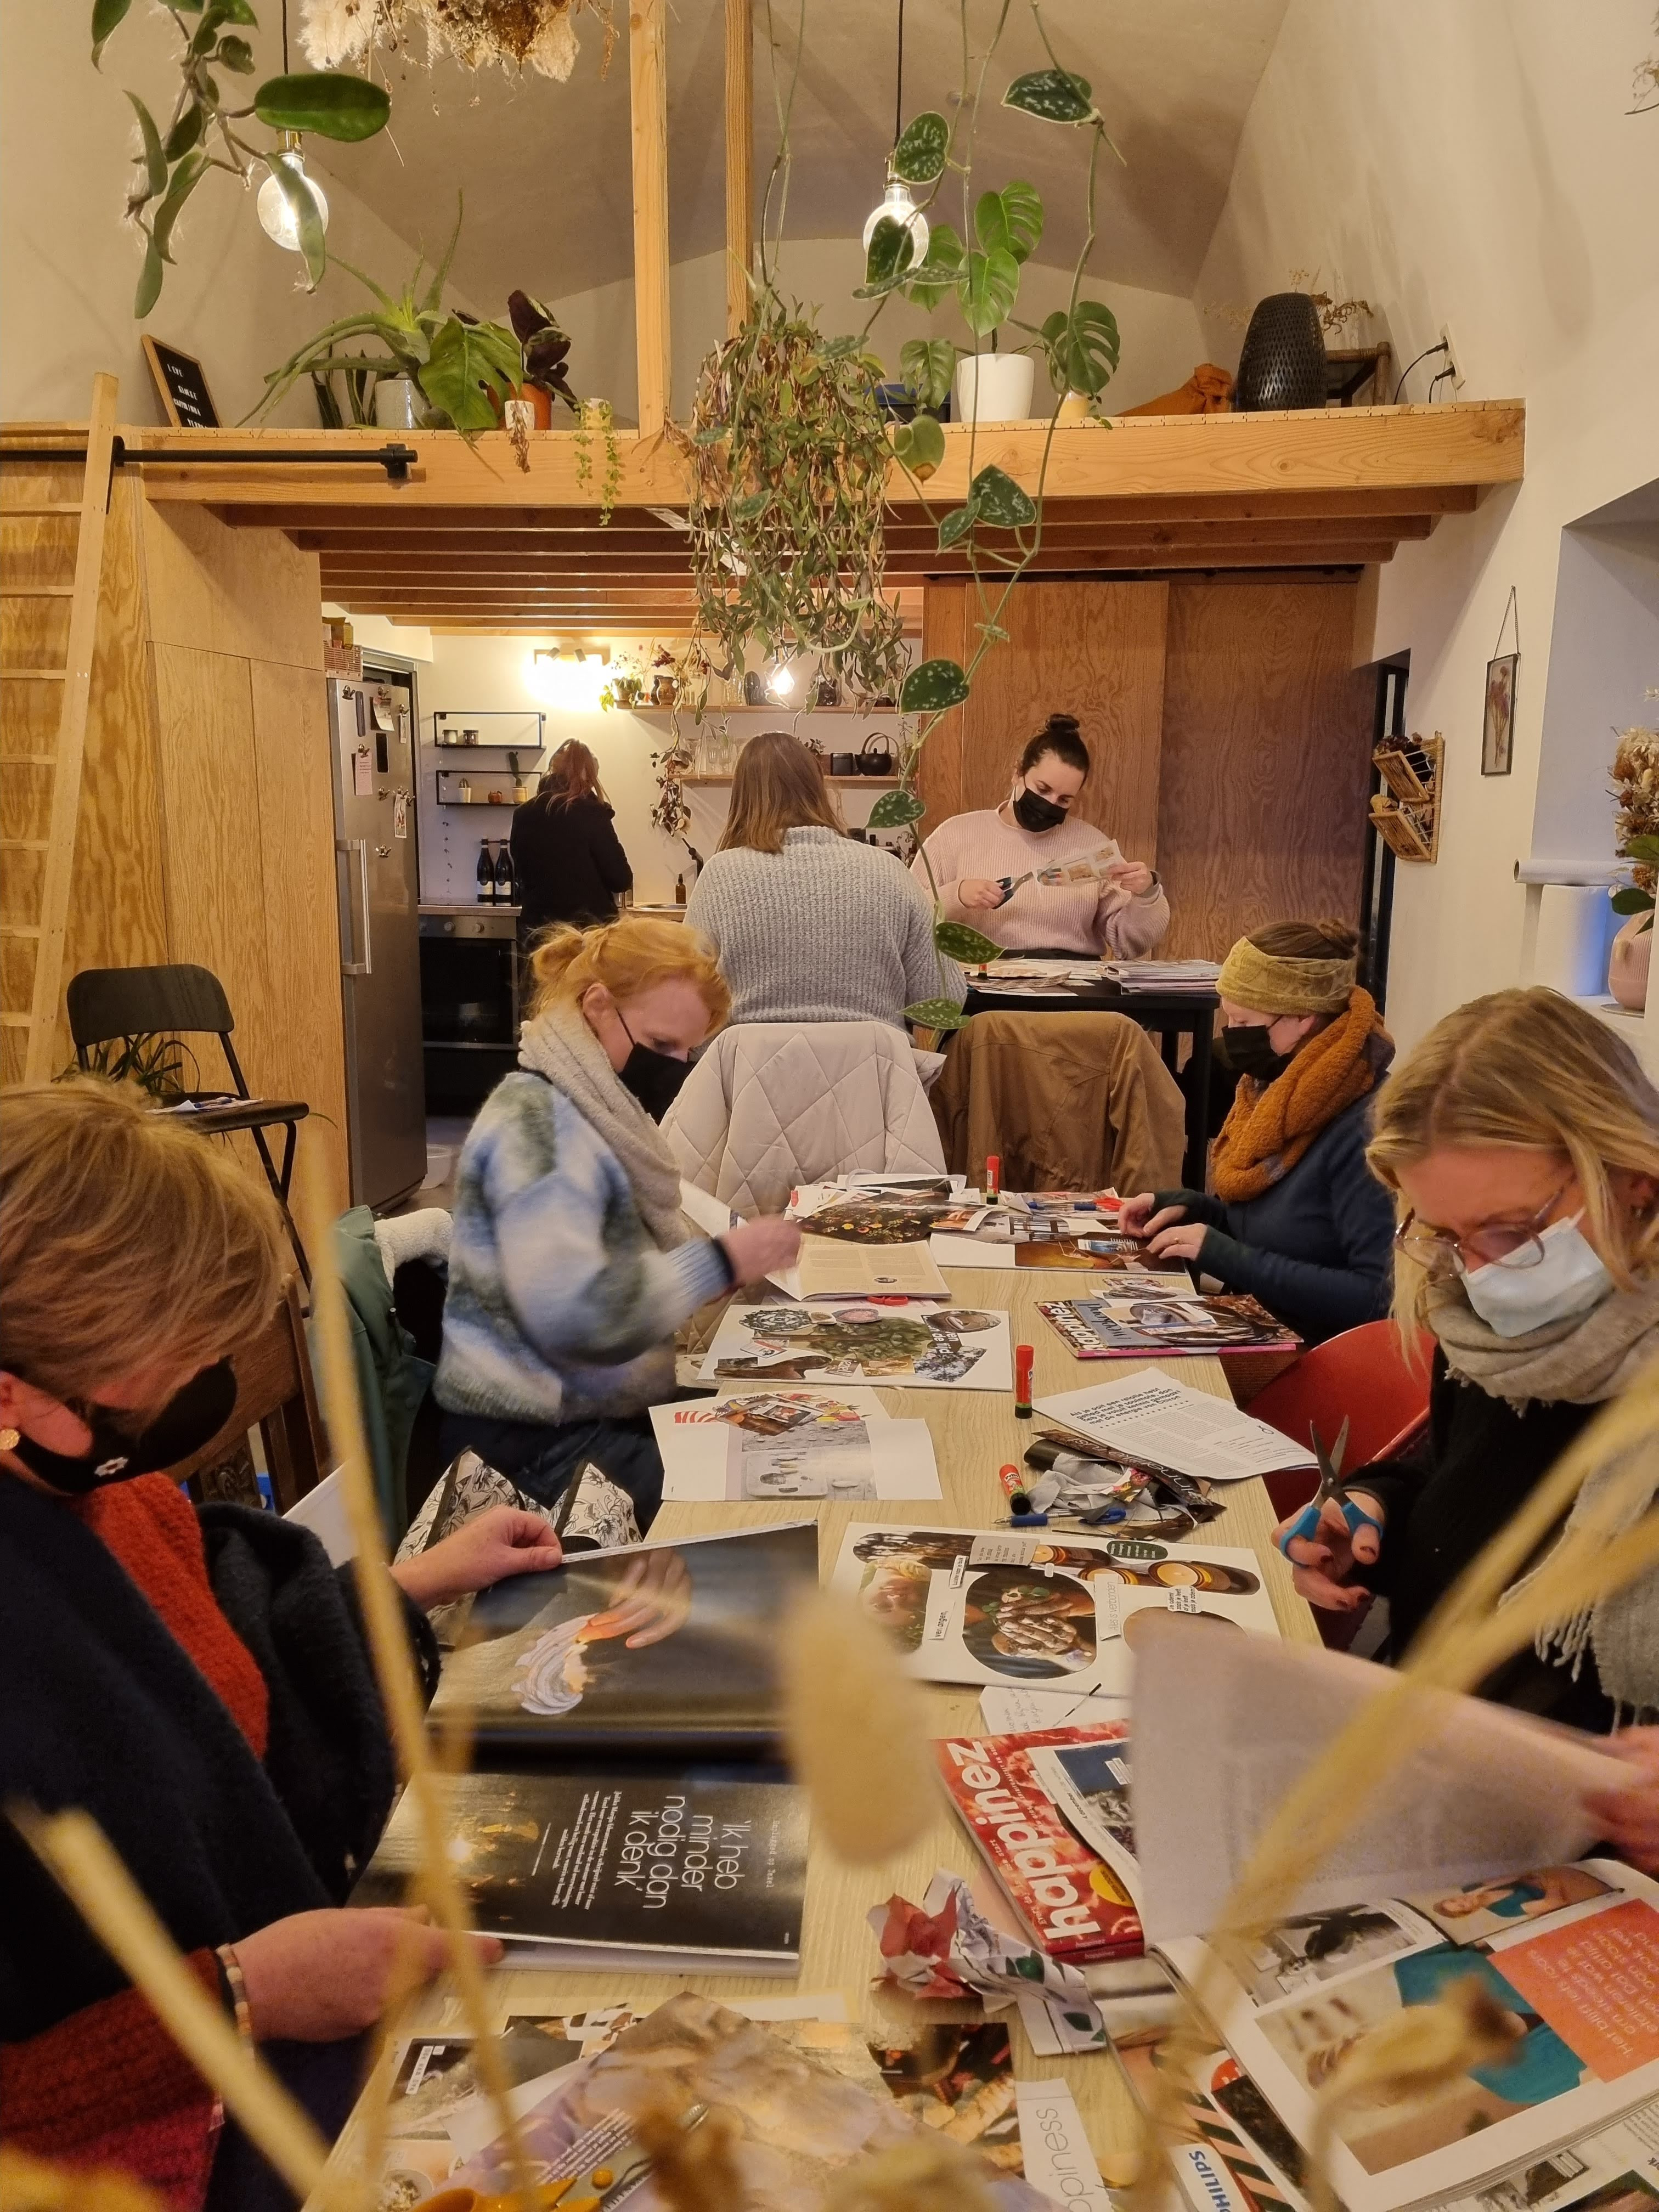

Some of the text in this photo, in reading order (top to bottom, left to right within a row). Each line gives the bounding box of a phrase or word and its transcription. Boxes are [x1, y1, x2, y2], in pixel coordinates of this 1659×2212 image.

[932, 1333, 953, 1353] de tijd
[1121, 1393, 1143, 1403] relatie
[1107, 1581, 1118, 1611] verbonden
[629, 1810, 659, 1826] ik
[642, 1796, 686, 1908] nodig dan
[680, 1815, 718, 1892] minder
[947, 1741, 1101, 1939] happinez
[988, 1838, 1005, 1858] start
[714, 1846, 749, 1889] heb
